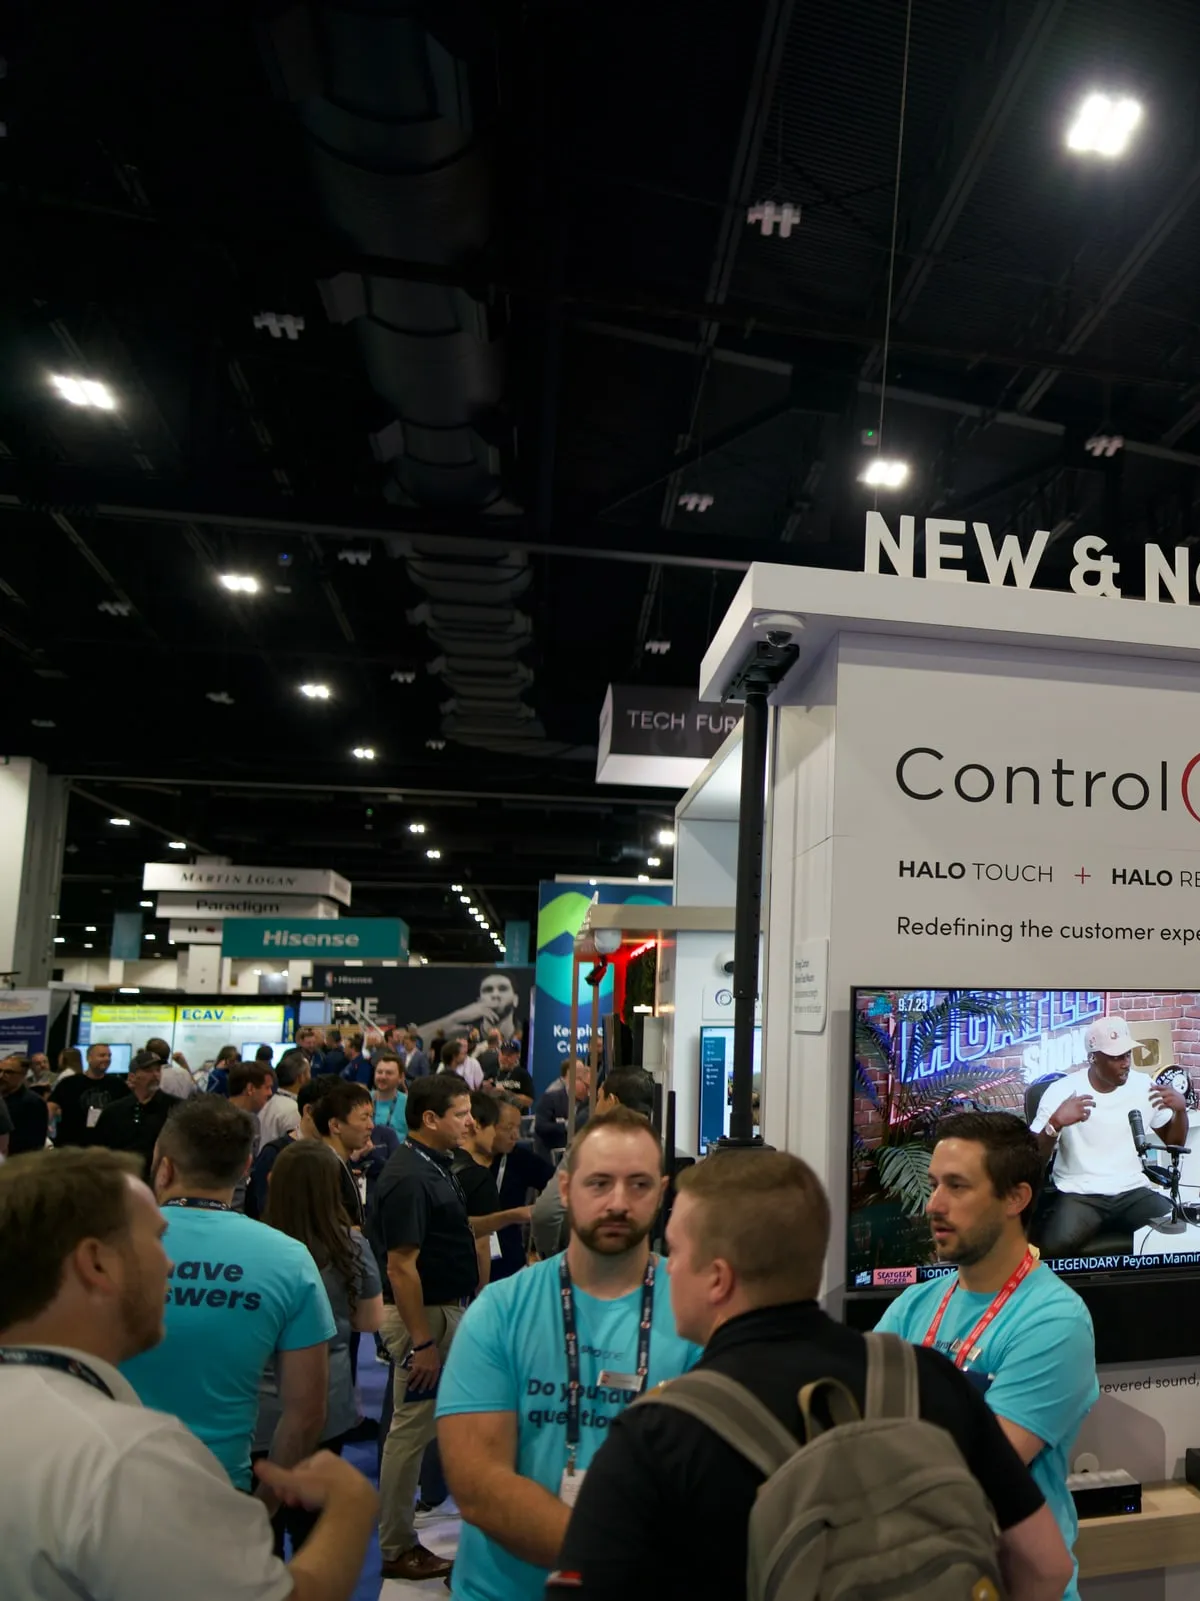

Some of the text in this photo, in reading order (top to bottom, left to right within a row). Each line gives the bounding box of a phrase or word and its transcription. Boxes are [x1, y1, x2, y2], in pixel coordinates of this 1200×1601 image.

[864, 511, 1051, 588] NEW
[1069, 535, 1121, 599] &
[627, 709, 741, 733] TECH FUR
[181, 872, 297, 887] MARTIN LOGAN
[898, 860, 966, 879] HALO
[972, 862, 1053, 883] TOUCH
[1111, 868, 1174, 886] HALO
[196, 900, 280, 915] Paradigm
[897, 916, 1013, 943] Redefining
[1020, 919, 1053, 938] the
[1060, 922, 1155, 940] customer
[262, 930, 360, 947] Hisense
[898, 998, 927, 1012] 9.7.23
[182, 1009, 224, 1020] ECAV
[1052, 1256, 1119, 1272] LEGENDARY
[1122, 1254, 1160, 1270] Peyton
[876, 1270, 912, 1279] SEATGEEK
[164, 1287, 262, 1311] wers
[527, 1379, 555, 1396] Do
[1099, 1376, 1152, 1393] revered
[1155, 1373, 1200, 1388] sound,
